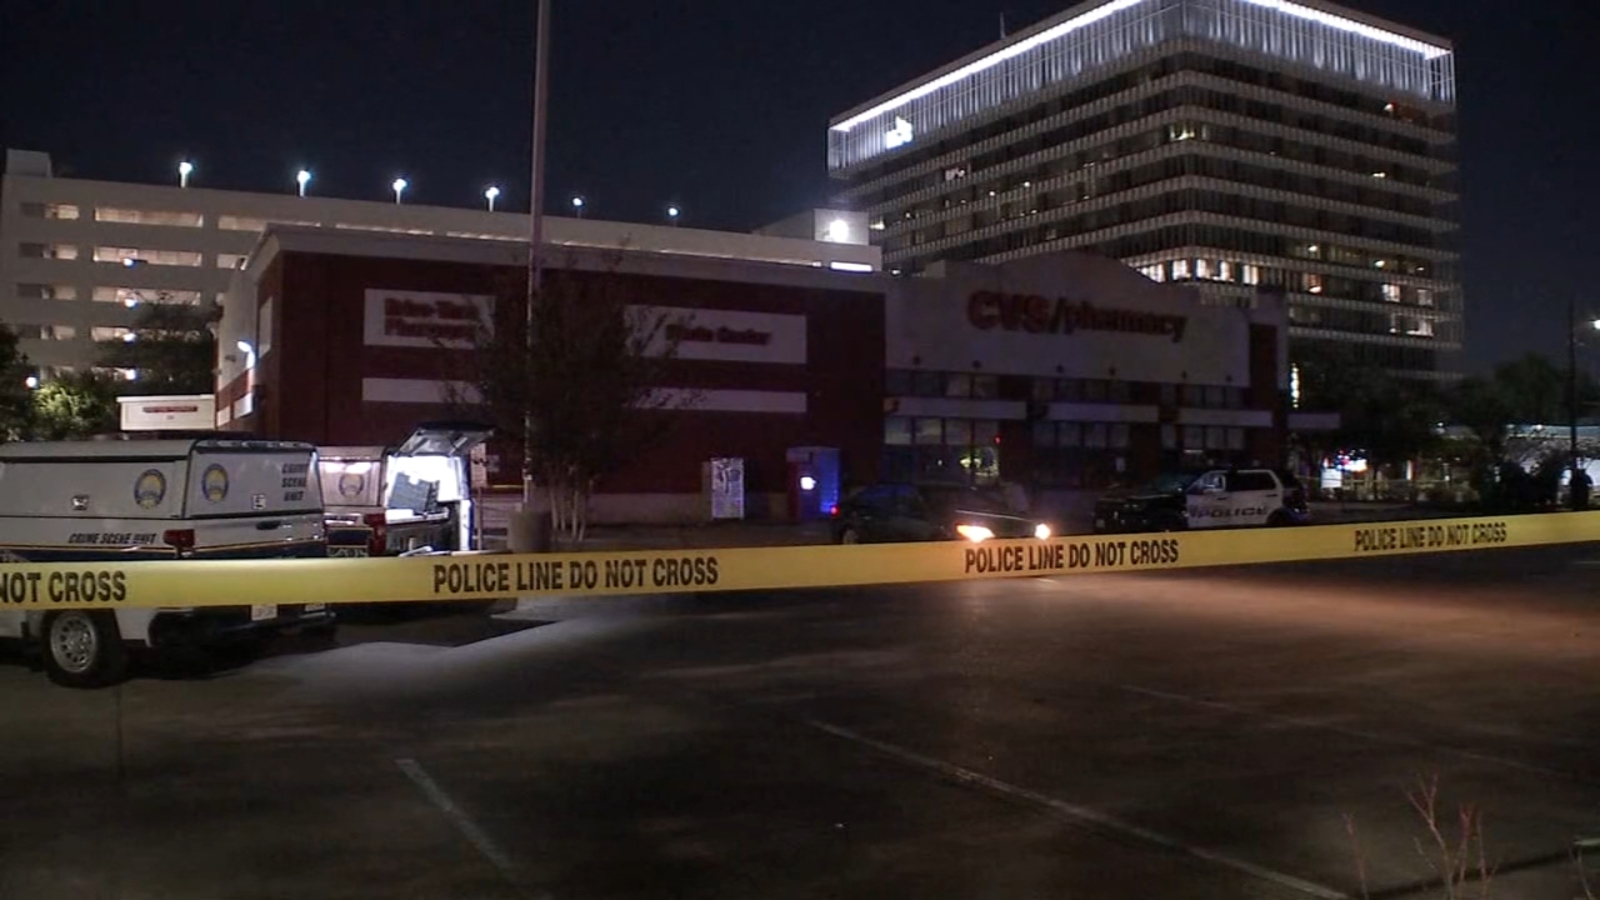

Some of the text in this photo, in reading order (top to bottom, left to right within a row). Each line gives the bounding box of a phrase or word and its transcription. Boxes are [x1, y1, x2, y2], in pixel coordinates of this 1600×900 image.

[1198, 507, 1267, 518] POLICE
[1355, 522, 1507, 551] POLICE LINE DO NOT CROSS
[965, 539, 1179, 573] POLICE LINE DO NOT CROSS
[49, 570, 126, 602] CROSS
[433, 556, 719, 594] POLICE LINE DO NOT CROSS
